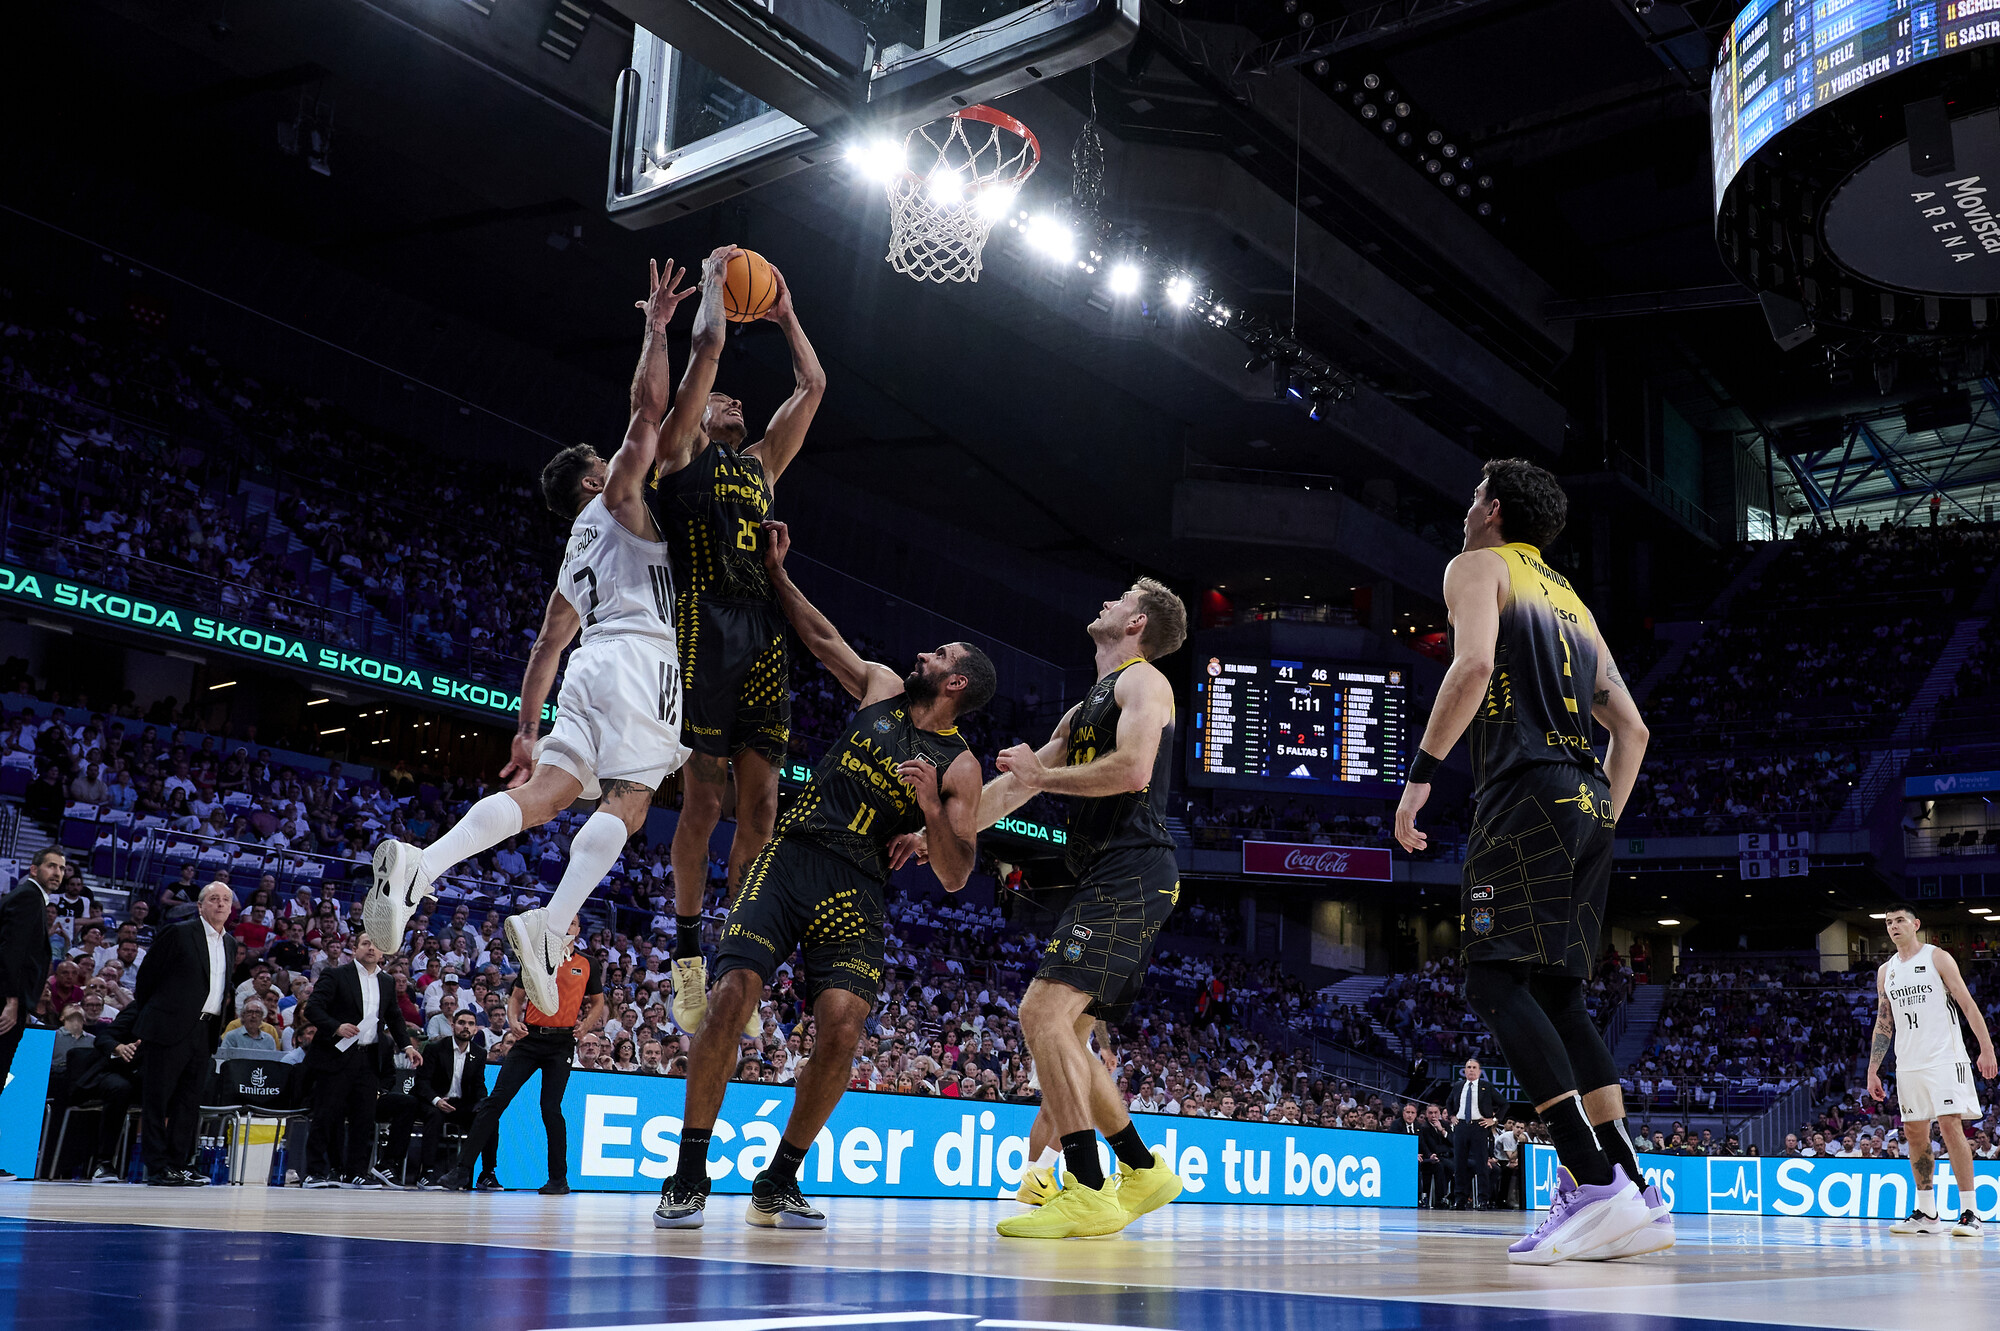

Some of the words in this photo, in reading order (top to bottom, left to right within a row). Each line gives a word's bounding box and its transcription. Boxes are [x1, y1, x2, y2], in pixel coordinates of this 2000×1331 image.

[1742, 17, 1768, 54] KRAMER
[1783, 23, 1794, 44] 2F
[1945, 31, 1958, 48] 15
[1816, 56, 1828, 75] 24
[1830, 42, 1854, 68] FELIZ
[1898, 18, 1910, 37] 1F
[1784, 49, 1795, 69] 0F
[1818, 83, 1830, 101] 77
[1831, 54, 1890, 94] YURTSEVEN
[1896, 45, 1912, 66] 2F
[1922, 39, 1930, 56] 7
[1785, 75, 1796, 95] 0F
[1802, 67, 1808, 83] 2
[1786, 101, 1796, 121] 0F
[1802, 93, 1810, 110] 12
[1910, 192, 1976, 262] ARENA
[737, 518, 760, 552] 25
[573, 566, 599, 627] 7
[1279, 666, 1293, 678] 41
[1312, 669, 1328, 681] 46
[1290, 696, 1320, 712] 1:11
[850, 730, 872, 752] LA
[1298, 734, 1305, 744] 2
[1277, 744, 1284, 755] 5
[1286, 747, 1318, 756] FALTAS
[1320, 748, 1328, 758] 5
[847, 802, 876, 836] 11
[1748, 834, 1759, 848] 2
[1787, 833, 1798, 847] 0
[1284, 849, 1351, 872] Coca-Cola
[1749, 862, 1760, 876] 0
[742, 929, 776, 954] Hospiten
[1074, 927, 1088, 938] acb
[833, 961, 868, 976] canarias
[1890, 984, 1932, 1000] Emirates
[1908, 995, 1926, 1006] BETTER
[240, 1084, 280, 1095] Emirates
[580, 1094, 914, 1184] Escáner
[1149, 1128, 1208, 1193] de
[1221, 1138, 1271, 1194] tu
[1285, 1137, 1381, 1198] boca
[1772, 1158, 2000, 1222] Santa
